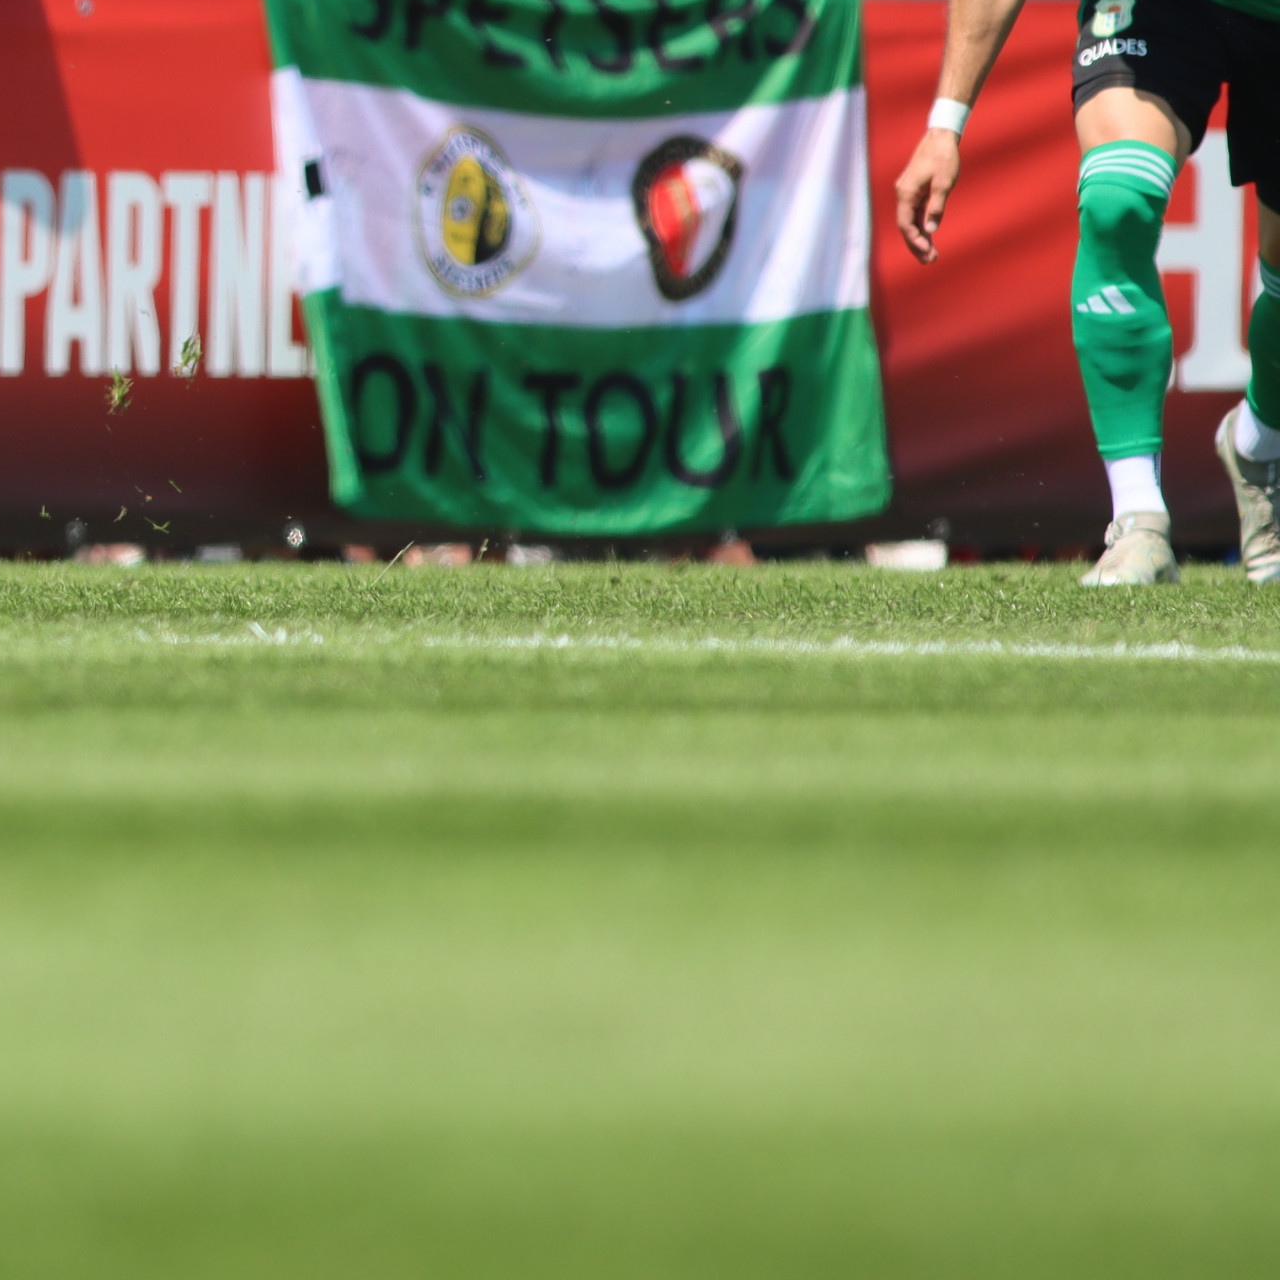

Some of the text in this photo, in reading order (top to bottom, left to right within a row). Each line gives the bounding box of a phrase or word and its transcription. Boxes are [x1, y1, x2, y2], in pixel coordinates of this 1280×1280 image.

[1078, 38, 1148, 67] QUADES
[350, 353, 797, 490] ON TOUR
